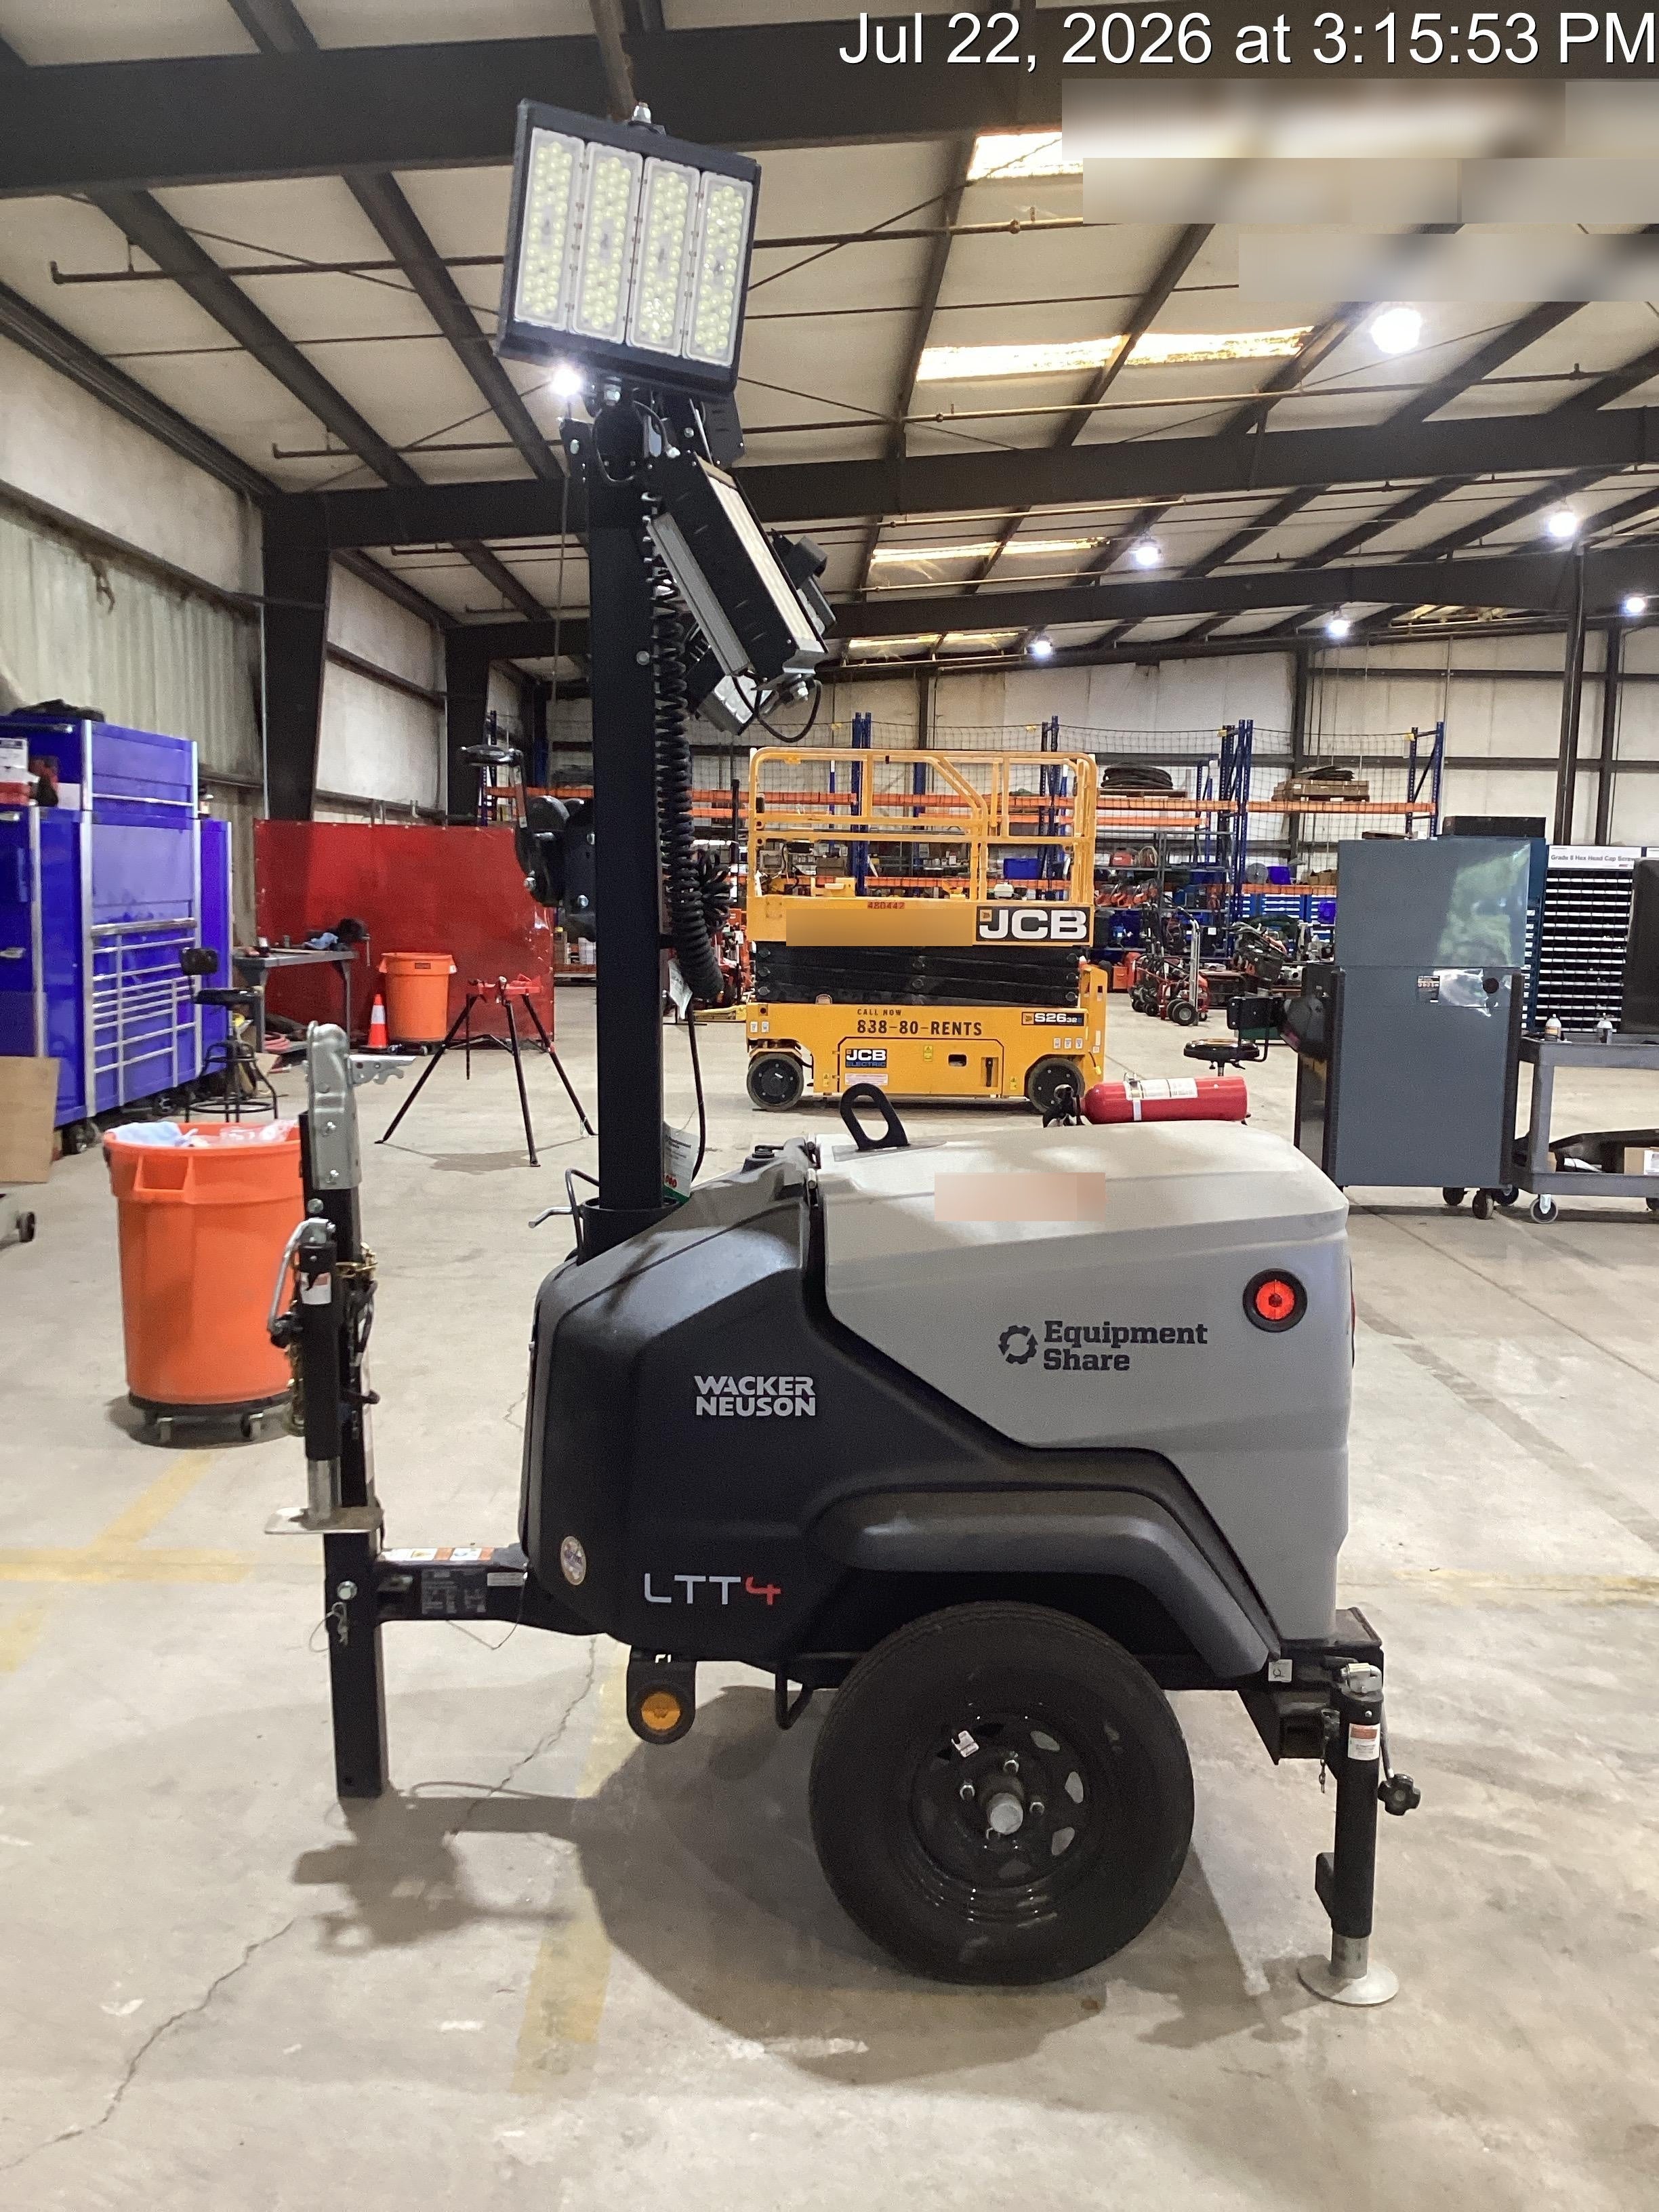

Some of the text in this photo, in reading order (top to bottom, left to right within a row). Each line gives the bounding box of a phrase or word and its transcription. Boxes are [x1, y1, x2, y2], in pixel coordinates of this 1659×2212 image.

[979, 909, 1087, 940] JCB
[857, 1019, 982, 1036] 838-80-RENTS
[846, 1049, 886, 1061] JCB
[1044, 1320, 1208, 1349] Equipment
[1044, 1348, 1130, 1371] Share
[694, 1375, 816, 1396] WACKER
[695, 1396, 816, 1417] NEUSON
[644, 1572, 781, 1605] LTT4
